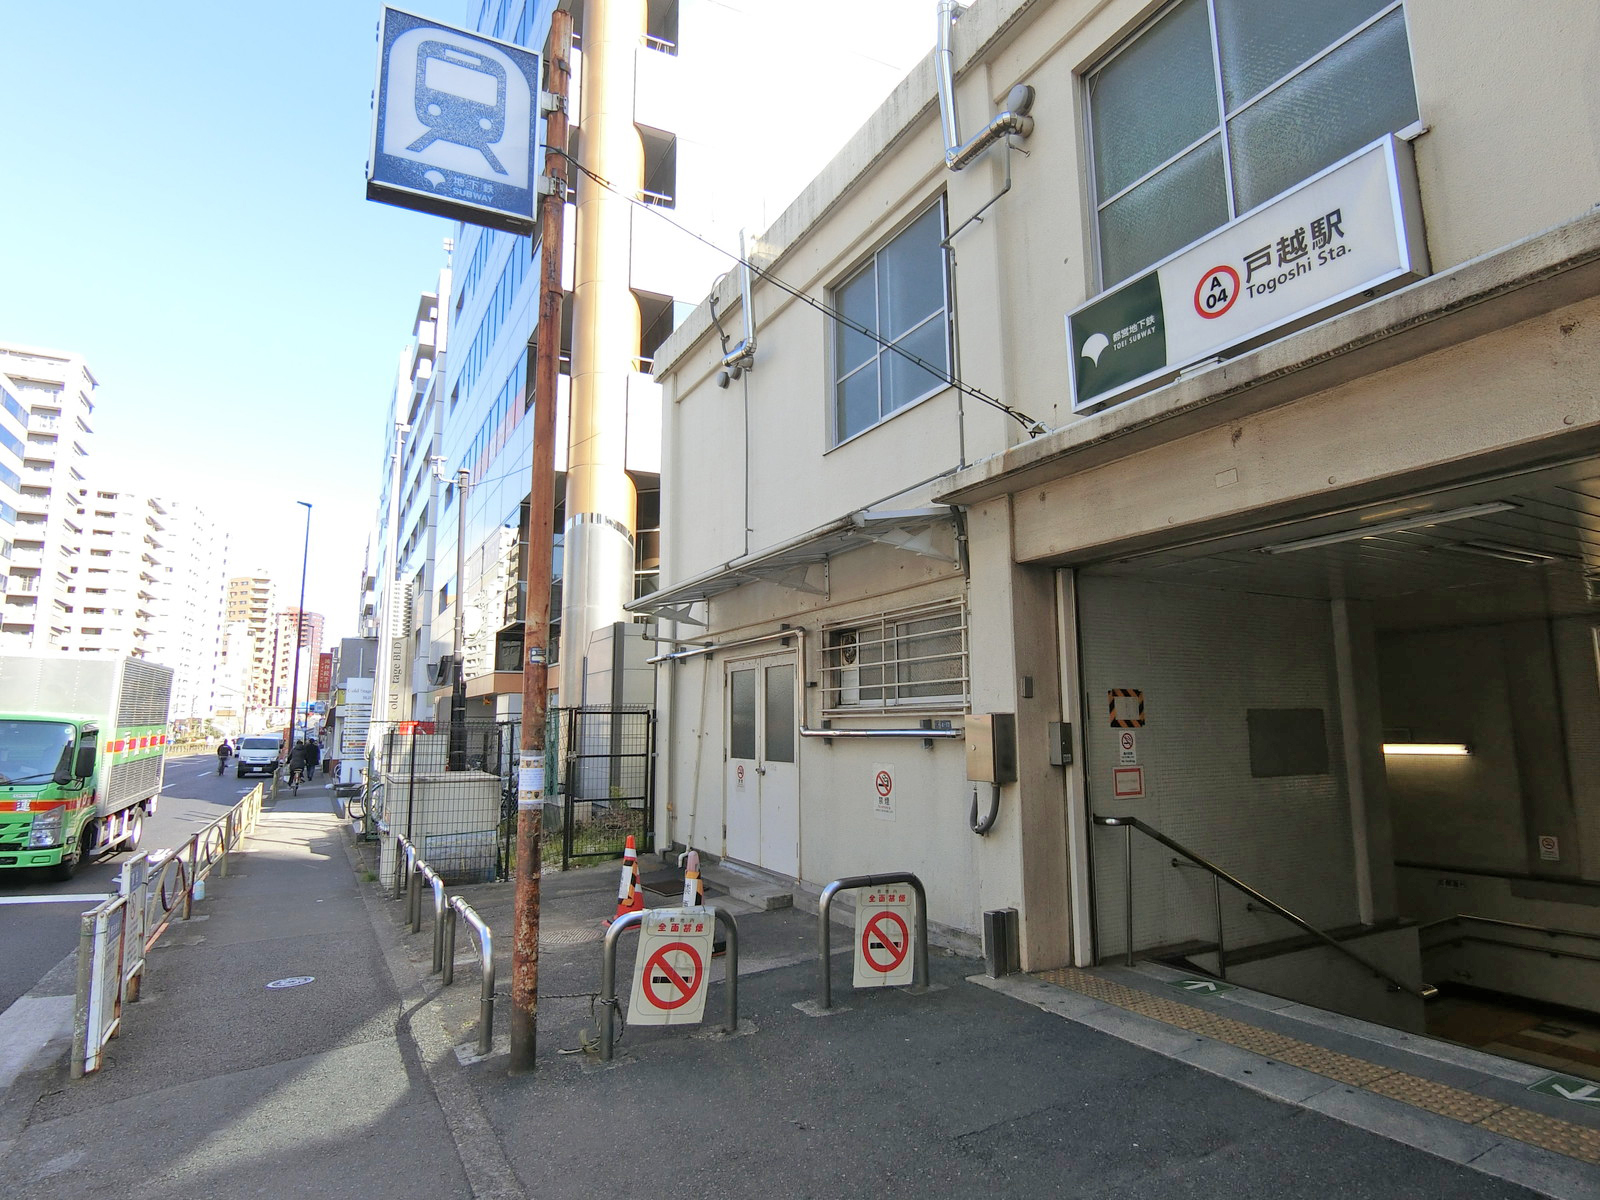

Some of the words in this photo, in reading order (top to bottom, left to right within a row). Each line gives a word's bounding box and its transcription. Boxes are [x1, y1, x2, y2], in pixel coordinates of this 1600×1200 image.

[453, 176, 494, 194] 地下鉄
[453, 187, 493, 203] SUBWAY
[1243, 208, 1345, 284] 戸越駅
[1246, 257, 1312, 298] Togoshi
[1318, 245, 1352, 266] Sta.
[1210, 276, 1222, 291] A
[1206, 288, 1228, 309] 04
[1112, 315, 1155, 342] 都営地下鉄
[1113, 340, 1127, 351] TOEI
[1129, 326, 1156, 344] SUBWAY
[868, 894, 906, 903] 全面禁煙
[657, 922, 704, 933] 全面禁煙
